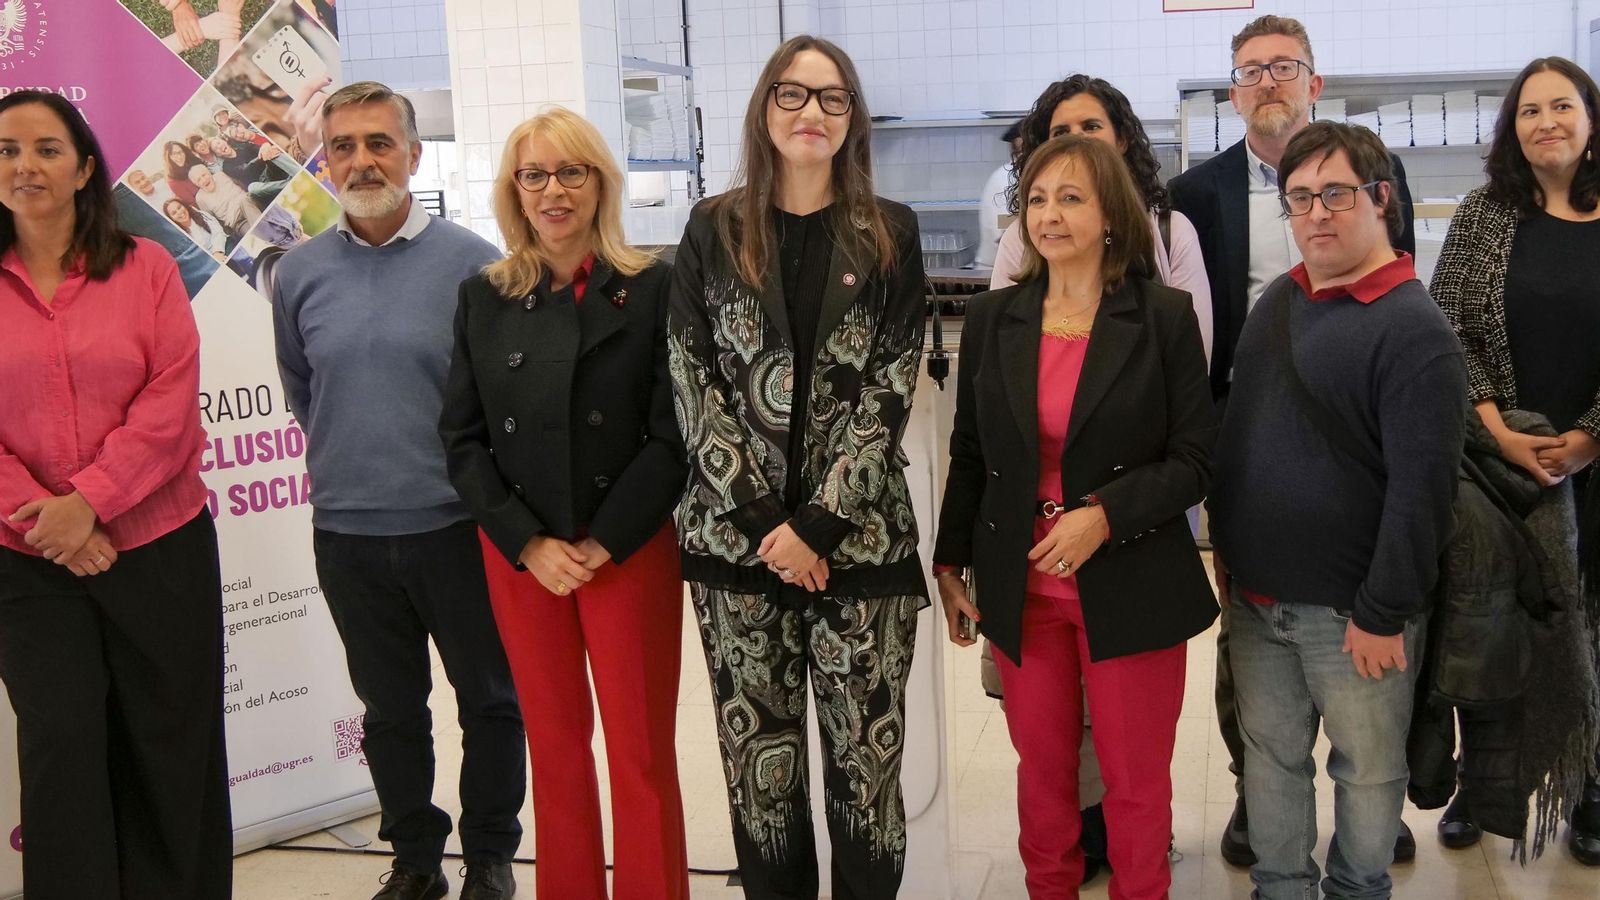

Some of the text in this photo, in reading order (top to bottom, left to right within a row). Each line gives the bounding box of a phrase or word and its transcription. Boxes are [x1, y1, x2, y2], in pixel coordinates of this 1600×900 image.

[199, 384, 272, 423] RADO
[200, 418, 304, 472] CLUSIÓ
[222, 576, 252, 593] ocial
[253, 594, 264, 607] el
[223, 679, 244, 694] cial
[224, 686, 309, 714] ón del Acoso
